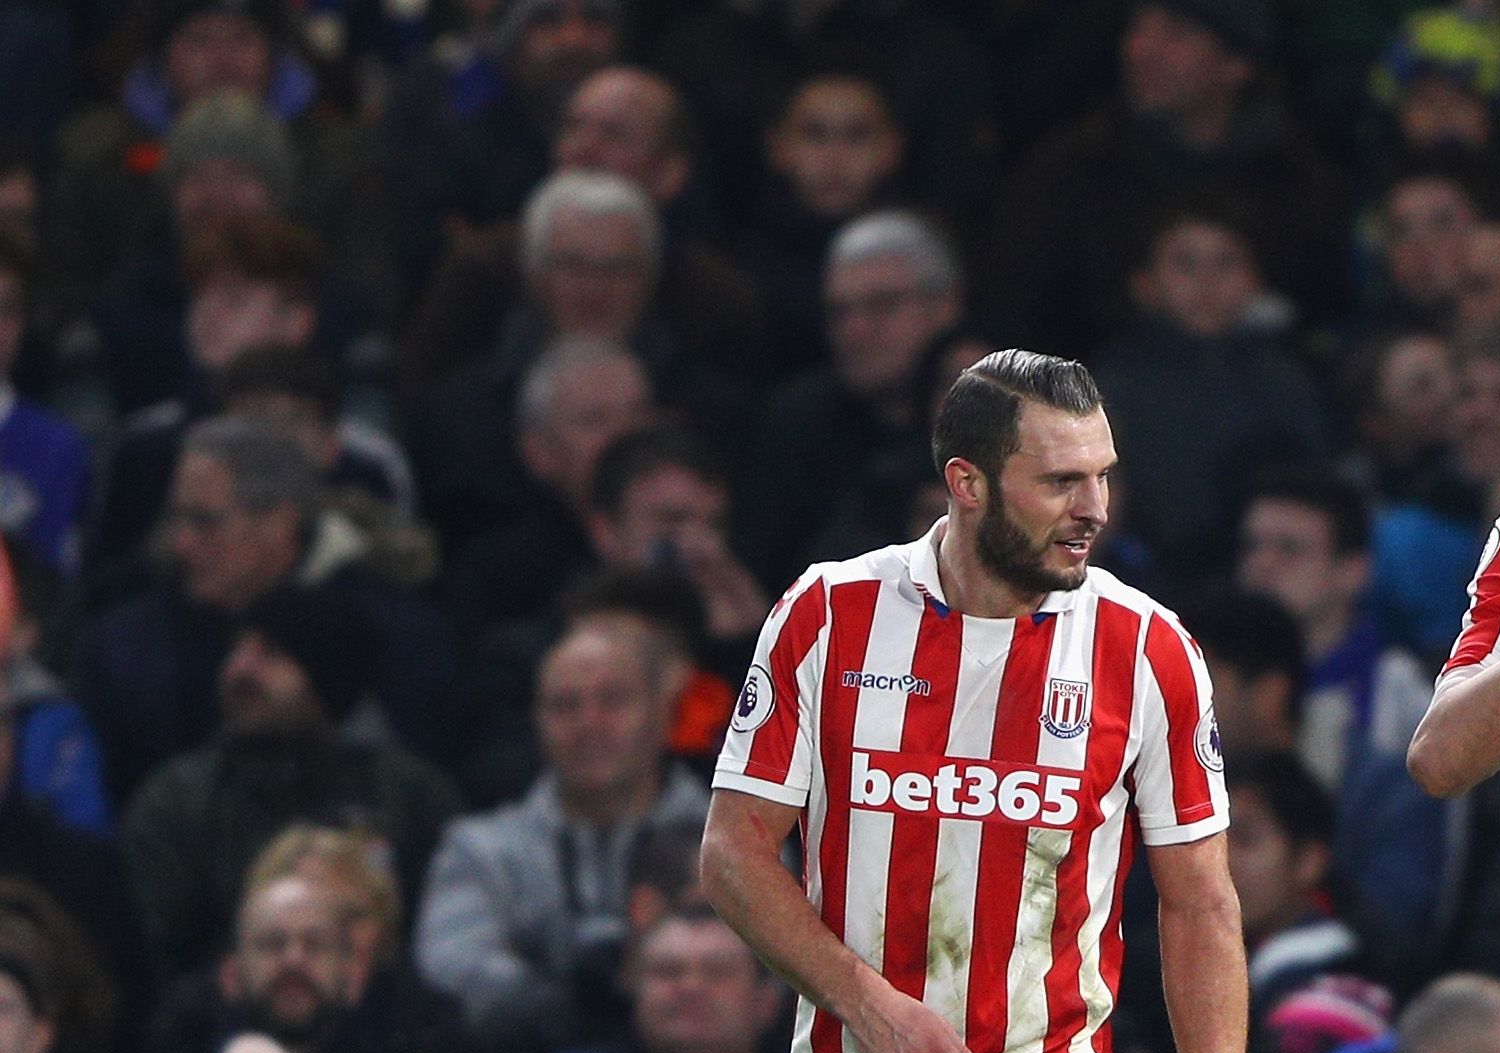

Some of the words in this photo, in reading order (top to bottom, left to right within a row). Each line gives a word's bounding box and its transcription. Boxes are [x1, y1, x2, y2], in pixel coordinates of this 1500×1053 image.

[843, 671, 931, 696] macron
[1053, 682, 1085, 693] STOKE
[849, 751, 1082, 826] bet365
